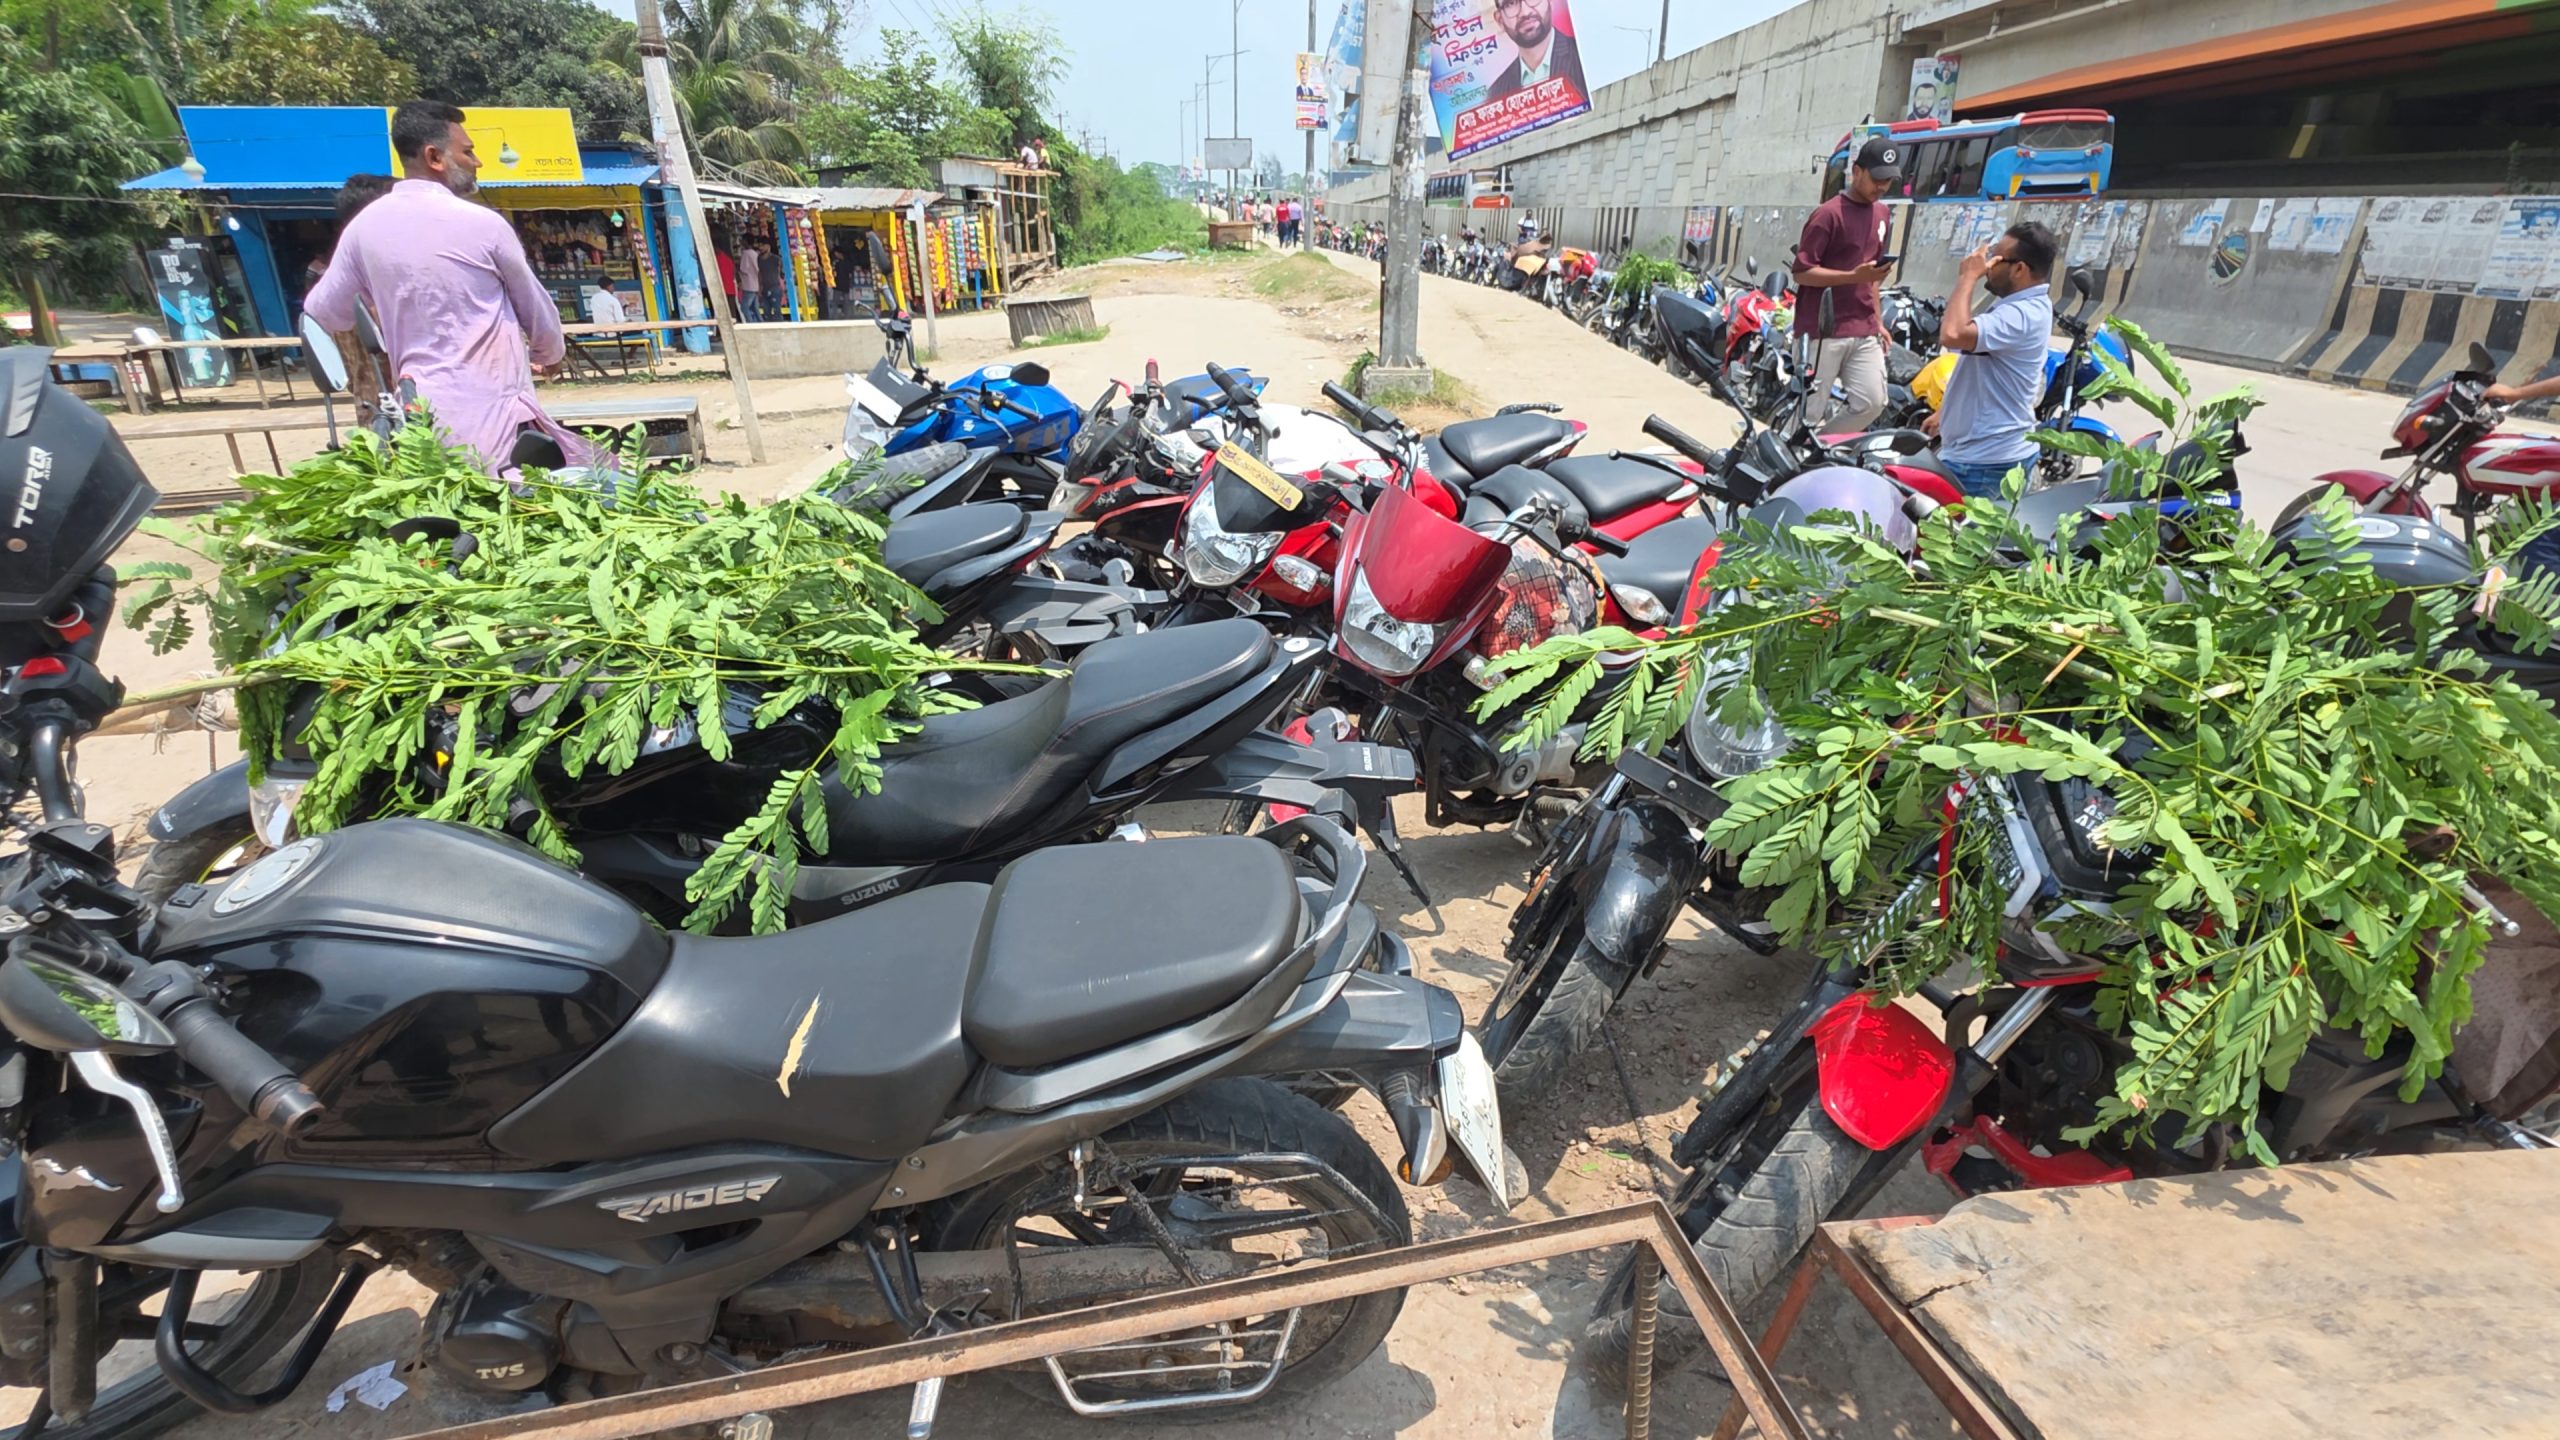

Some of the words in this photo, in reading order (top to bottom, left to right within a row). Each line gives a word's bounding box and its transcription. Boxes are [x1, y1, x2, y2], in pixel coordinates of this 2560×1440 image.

[1452, 14, 1483, 36] উল
[1444, 34, 1498, 67] ফিতর
[1505, 88, 1537, 112] হোসেন
[160, 255, 181, 267] DO
[167, 272, 192, 285] DEW
[12, 445, 53, 529] TORQ
[841, 878, 900, 905] SUZUKI
[596, 1175, 782, 1223] RAIDER
[475, 1363, 525, 1379] TVS
